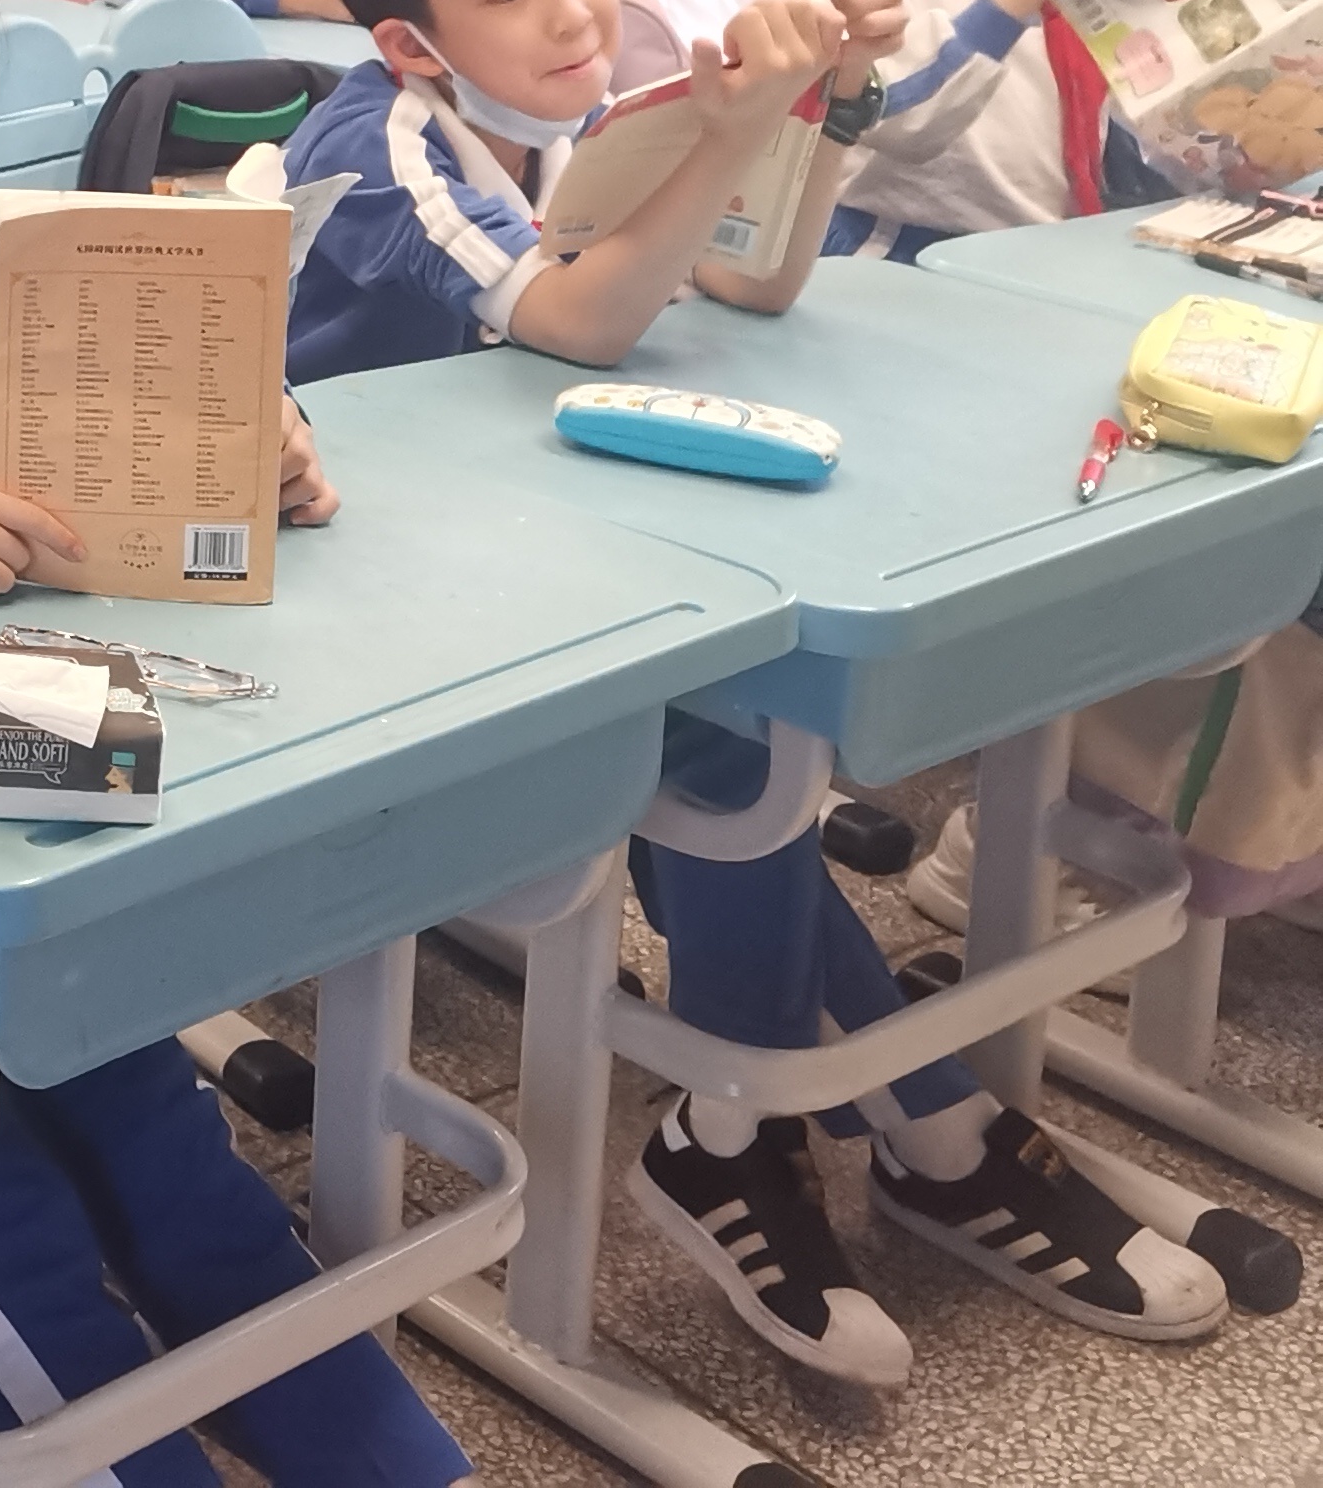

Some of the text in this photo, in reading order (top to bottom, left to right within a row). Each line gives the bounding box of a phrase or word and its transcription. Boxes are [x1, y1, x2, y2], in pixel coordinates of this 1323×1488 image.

[0, 730, 25, 742] ENJOY
[27, 731, 42, 742] THE
[0, 741, 65, 763] AND SOFT
